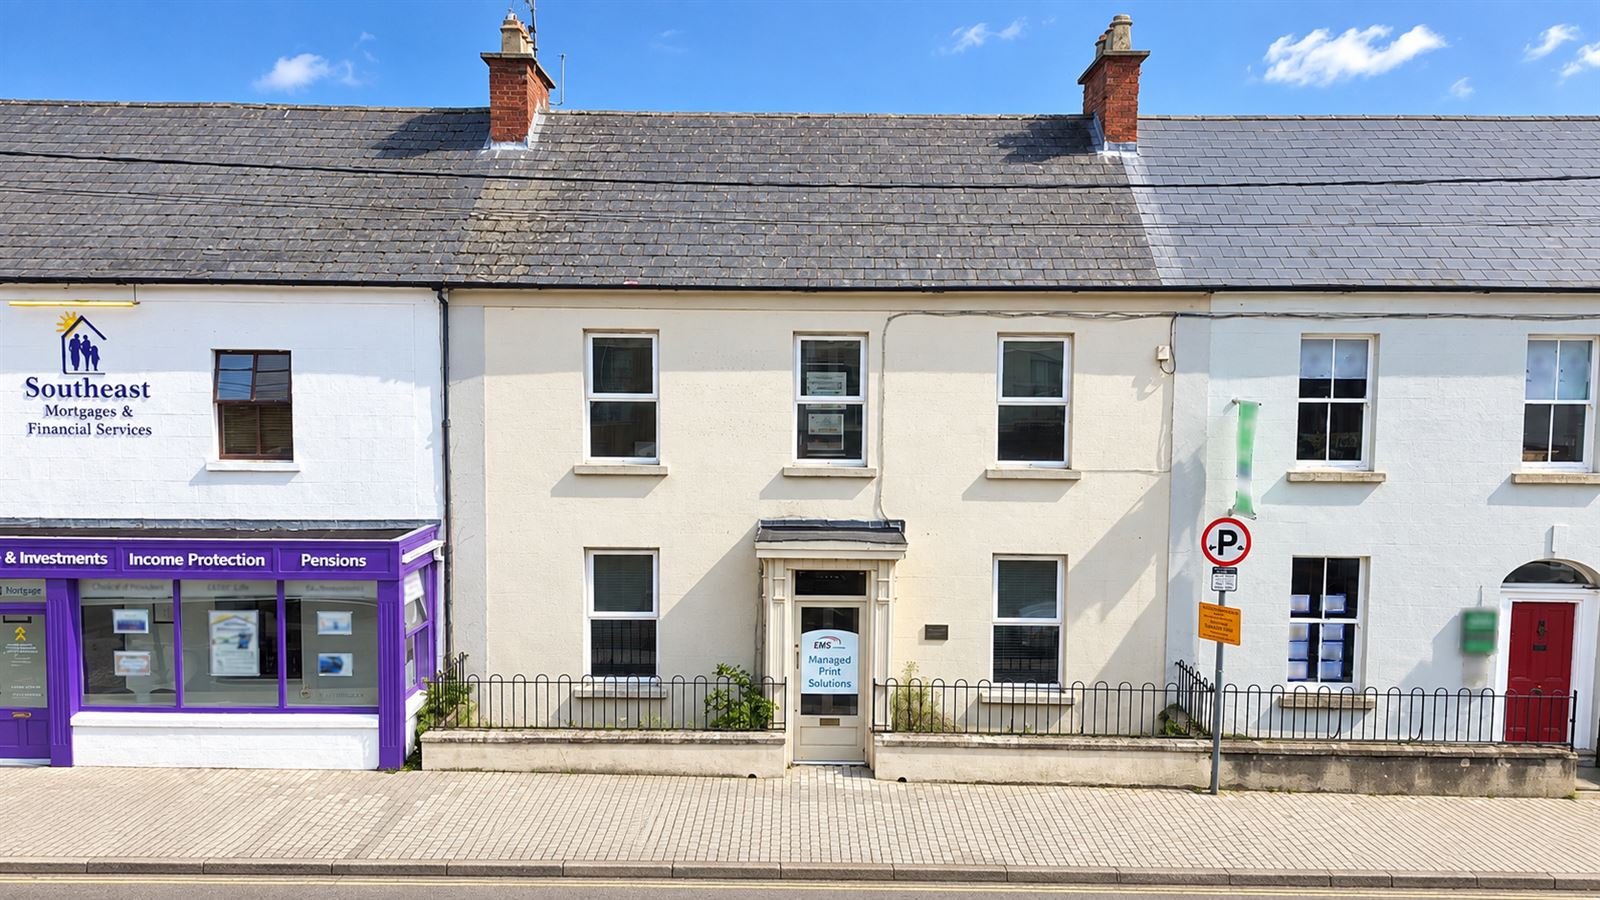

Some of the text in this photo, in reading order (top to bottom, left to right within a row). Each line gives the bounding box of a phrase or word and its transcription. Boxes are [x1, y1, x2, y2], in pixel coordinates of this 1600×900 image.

[25, 377, 151, 399] Southeast
[44, 404, 133, 420] Mortgages &
[27, 422, 152, 437] Financial Services
[1217, 529, 1238, 556] P
[4, 551, 108, 565] & Investments
[128, 552, 266, 568] Income Protection
[301, 553, 367, 567] Pensions
[813, 641, 832, 650] EMS
[808, 655, 852, 667] Managed
[818, 667, 842, 676] Print
[808, 678, 852, 688] Solutions
